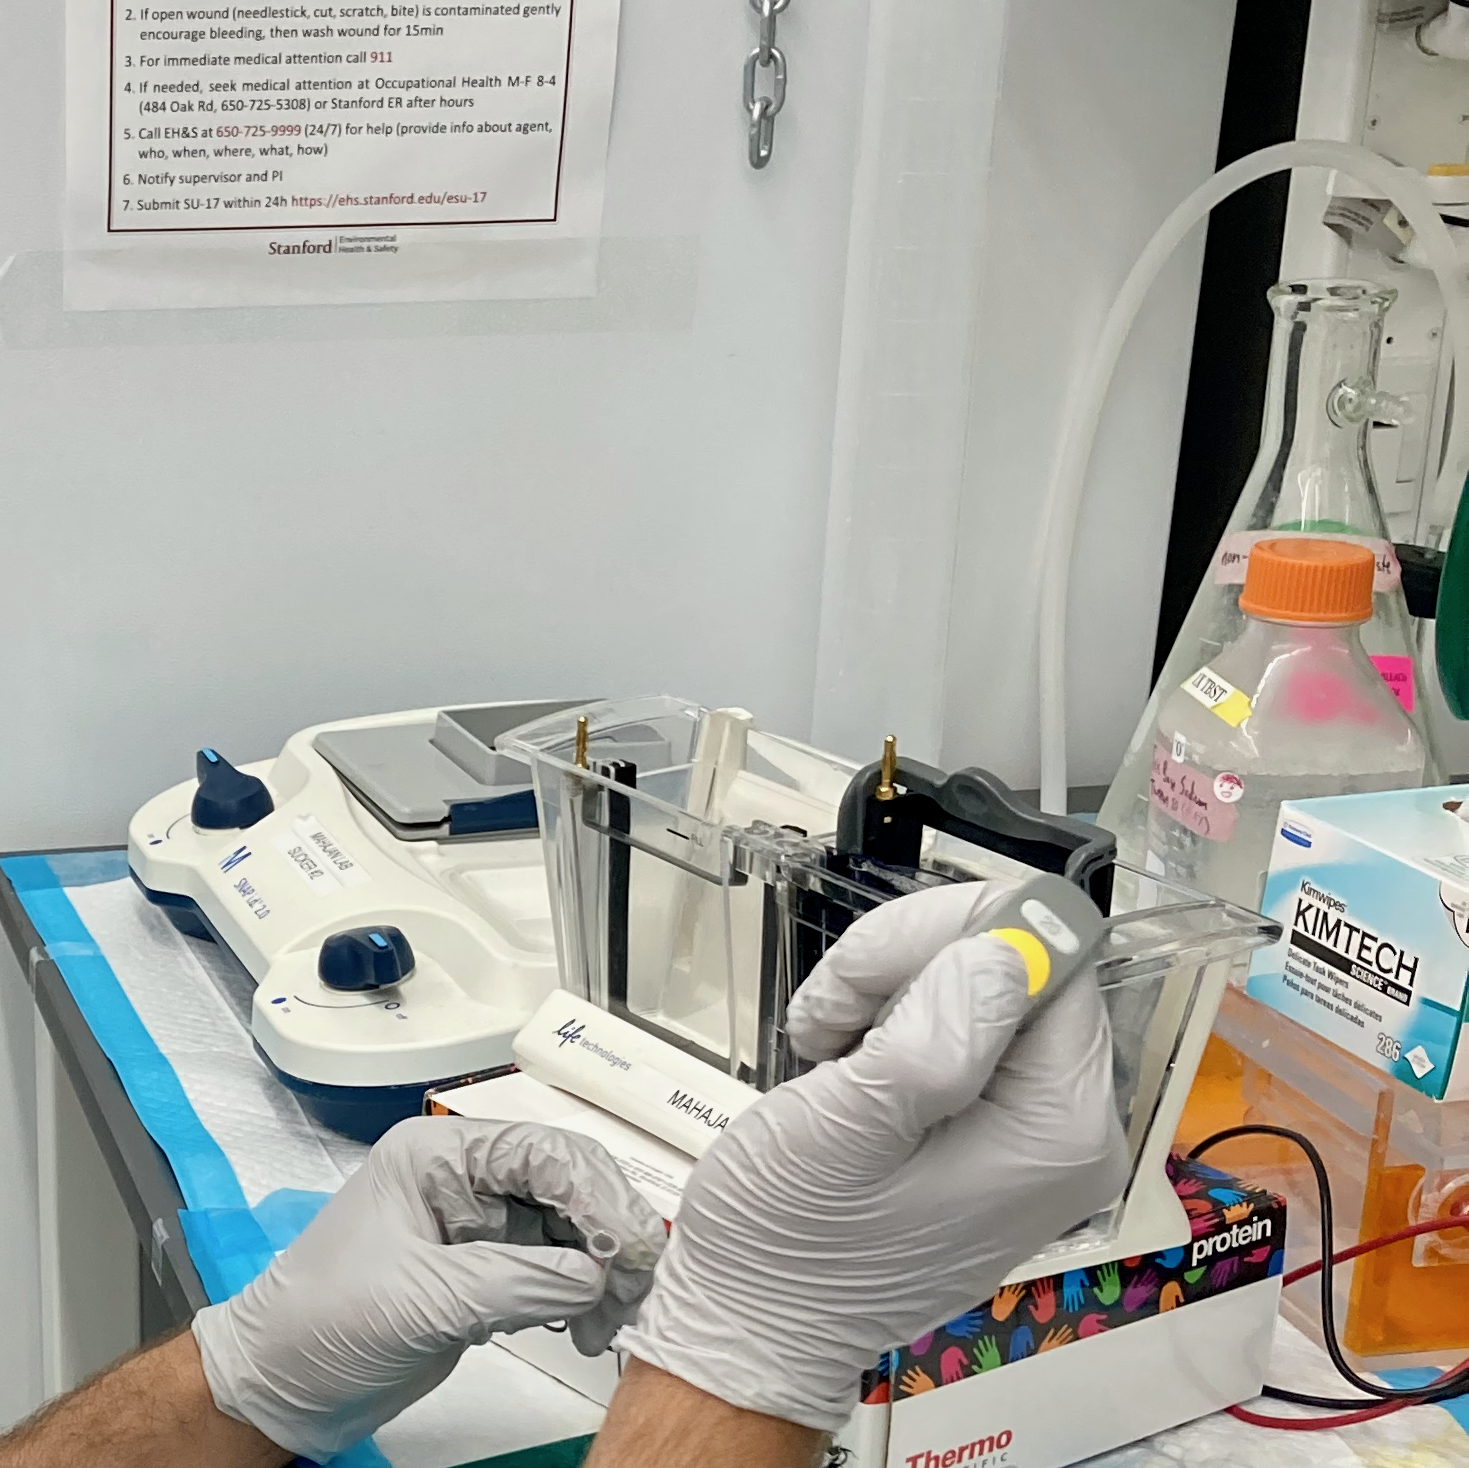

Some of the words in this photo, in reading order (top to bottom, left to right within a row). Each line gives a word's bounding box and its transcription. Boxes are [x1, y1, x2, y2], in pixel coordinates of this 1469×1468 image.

[125, 9, 137, 21] 2.
[140, 8, 149, 21] If
[152, 10, 182, 23] open
[186, 7, 229, 20] wound
[232, 6, 311, 22] (needlestick,
[314, 7, 337, 19] cut,
[339, 5, 387, 18] scratch,
[391, 4, 419, 18] bite)
[422, 5, 431, 17] is
[434, 4, 520, 17] contaminated
[522, 3, 561, 18] gently
[140, 29, 206, 42] encourage
[209, 26, 266, 41] bleeding,
[270, 26, 298, 38] then
[302, 25, 333, 38] wash
[337, 25, 379, 37] wound
[383, 24, 401, 37] for
[405, 24, 444, 37] 15min
[124, 55, 136, 68] 3.
[140, 55, 160, 68] For
[164, 54, 230, 67] immediate
[234, 53, 282, 66] medical
[285, 52, 342, 65] attention
[346, 51, 367, 64] call
[370, 51, 393, 64] 911
[124, 82, 136, 95] 4.
[140, 81, 149, 94] If
[153, 80, 203, 95] needed,
[209, 80, 237, 92] seek
[242, 78, 290, 92] medical
[295, 78, 352, 91] attention
[357, 78, 370, 90] at
[375, 76, 456, 91] Occupational
[461, 75, 502, 88] Health
[507, 75, 532, 88] M-F
[536, 75, 556, 87] 8-4
[139, 100, 166, 116] (484
[170, 100, 194, 113] Oak
[198, 99, 217, 113] Rd,
[221, 97, 311, 113] 650-725-5308)
[314, 99, 327, 110] or
[331, 96, 384, 110] Stanford
[387, 96, 403, 109] ER
[406, 96, 436, 109] after
[439, 96, 474, 108] hours
[123, 128, 135, 140] 5.
[139, 127, 161, 140] Call
[164, 127, 198, 139] EH&S
[201, 127, 213, 139] at
[216, 124, 301, 138] 650-725-9999
[304, 123, 342, 139] (24/7)
[345, 123, 363, 135] for
[366, 122, 393, 138] help
[396, 121, 447, 137] (provide
[450, 121, 474, 134] info
[477, 121, 512, 133] about
[515, 120, 553, 135] agent,
[138, 147, 169, 160] who,
[172, 146, 210, 159] when,
[213, 145, 255, 158] where,
[259, 144, 293, 157] what,
[297, 143, 328, 157] how)
[122, 174, 135, 186] 6.
[138, 172, 175, 187] Notify
[179, 172, 242, 186] supervisor
[246, 170, 268, 183] and
[272, 170, 283, 182] PI
[122, 200, 134, 211] 7.
[137, 198, 180, 211] Submit
[184, 197, 219, 210] SU-17
[223, 196, 261, 209] within
[265, 196, 287, 208] 24h
[291, 191, 487, 208] https://ehs.stanford.edu/esu-17
[268, 239, 332, 256] Stanford
[338, 234, 397, 244] Environmental
[338, 245, 364, 254] Health
[366, 245, 372, 254] &
[374, 244, 399, 255] Safety
[1200, 678, 1227, 702] TBST
[333, 855, 354, 871] LAB
[233, 877, 254, 897] SNAP
[1294, 897, 1419, 988] KIMTECH
[552, 1018, 586, 1047] life
[579, 1036, 632, 1071] technologies
[1376, 1032, 1402, 1062] 286
[1191, 1216, 1272, 1267] protein
